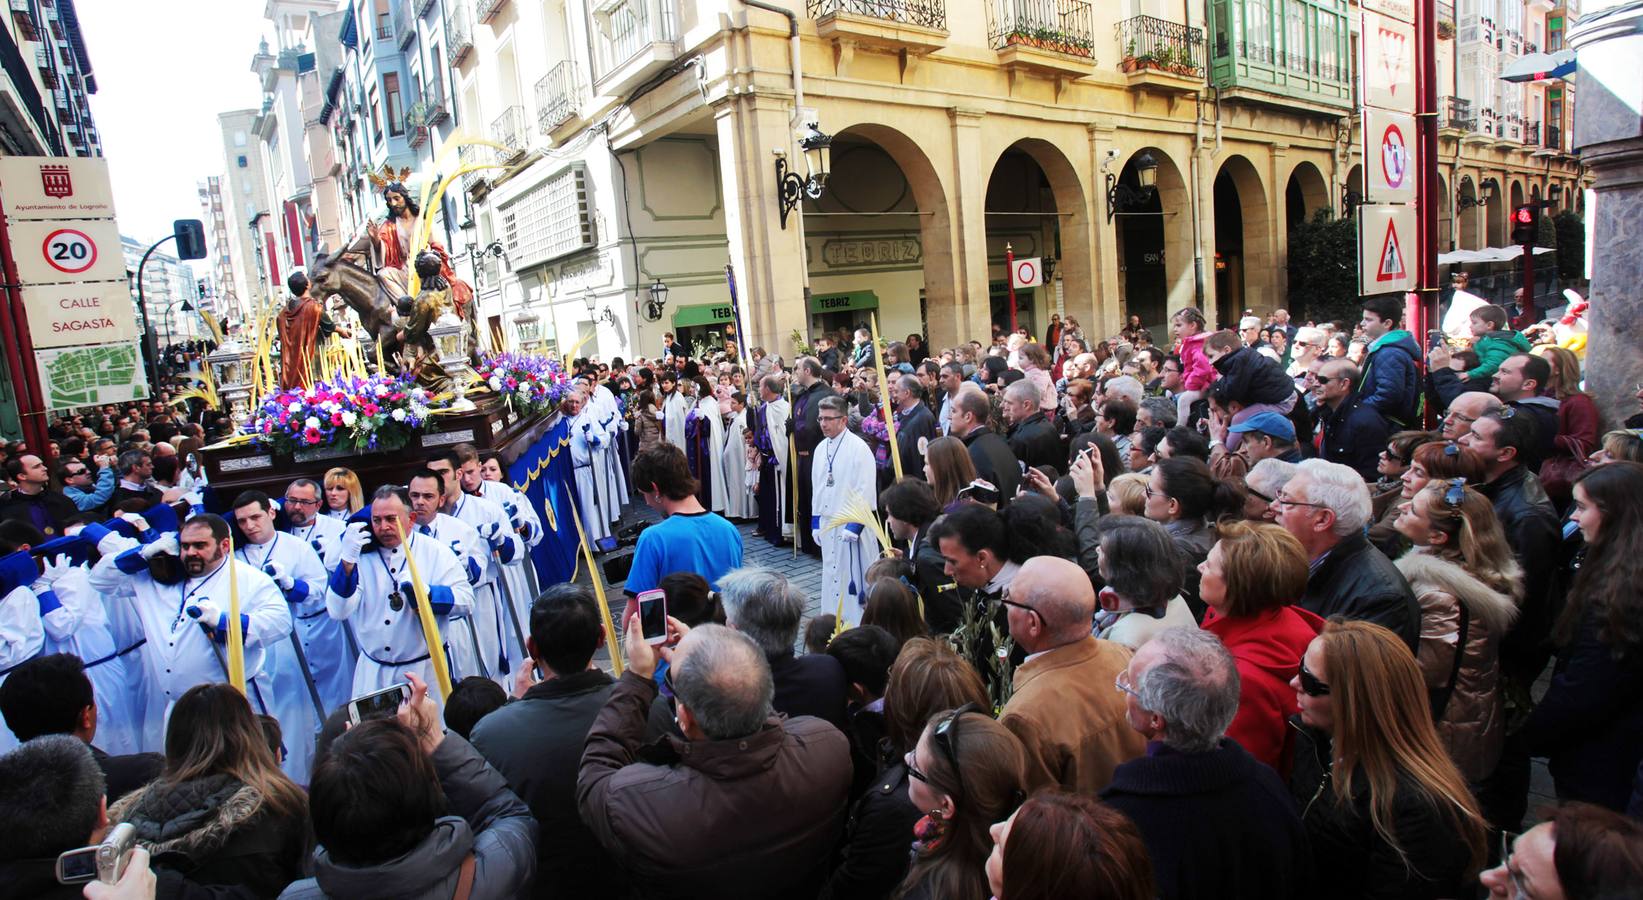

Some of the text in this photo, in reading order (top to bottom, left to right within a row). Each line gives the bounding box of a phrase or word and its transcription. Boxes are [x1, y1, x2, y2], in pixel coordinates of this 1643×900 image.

[15, 203, 66, 211] Ayuntamiento
[52, 242, 87, 260] 20
[830, 240, 916, 264] TEBRIZ
[60, 297, 101, 309] CALLE
[819, 296, 850, 308] TEBRIZ
[52, 318, 115, 332] SAGASTA
